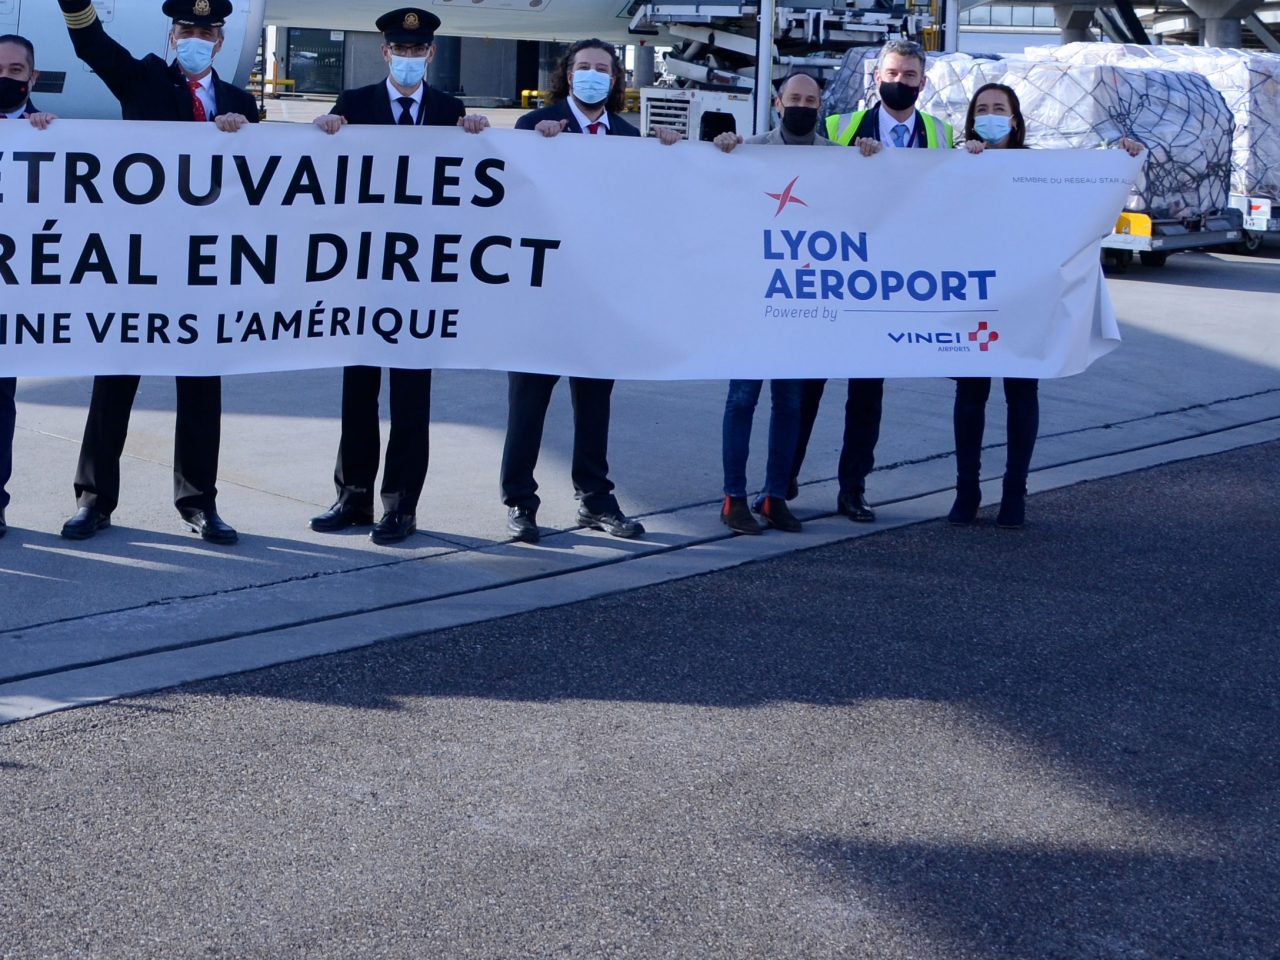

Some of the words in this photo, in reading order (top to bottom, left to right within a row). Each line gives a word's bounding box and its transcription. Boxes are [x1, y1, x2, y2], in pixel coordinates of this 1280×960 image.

[1012, 176, 1048, 184] MEMBRE
[187, 234, 278, 286] EN
[305, 231, 562, 288] DIRECT
[763, 229, 868, 262] LYON
[764, 262, 997, 302] AÉROPORT
[85, 312, 199, 345] VERS
[764, 305, 818, 319] Powered
[822, 305, 838, 322] by
[887, 332, 961, 344] VINCI
